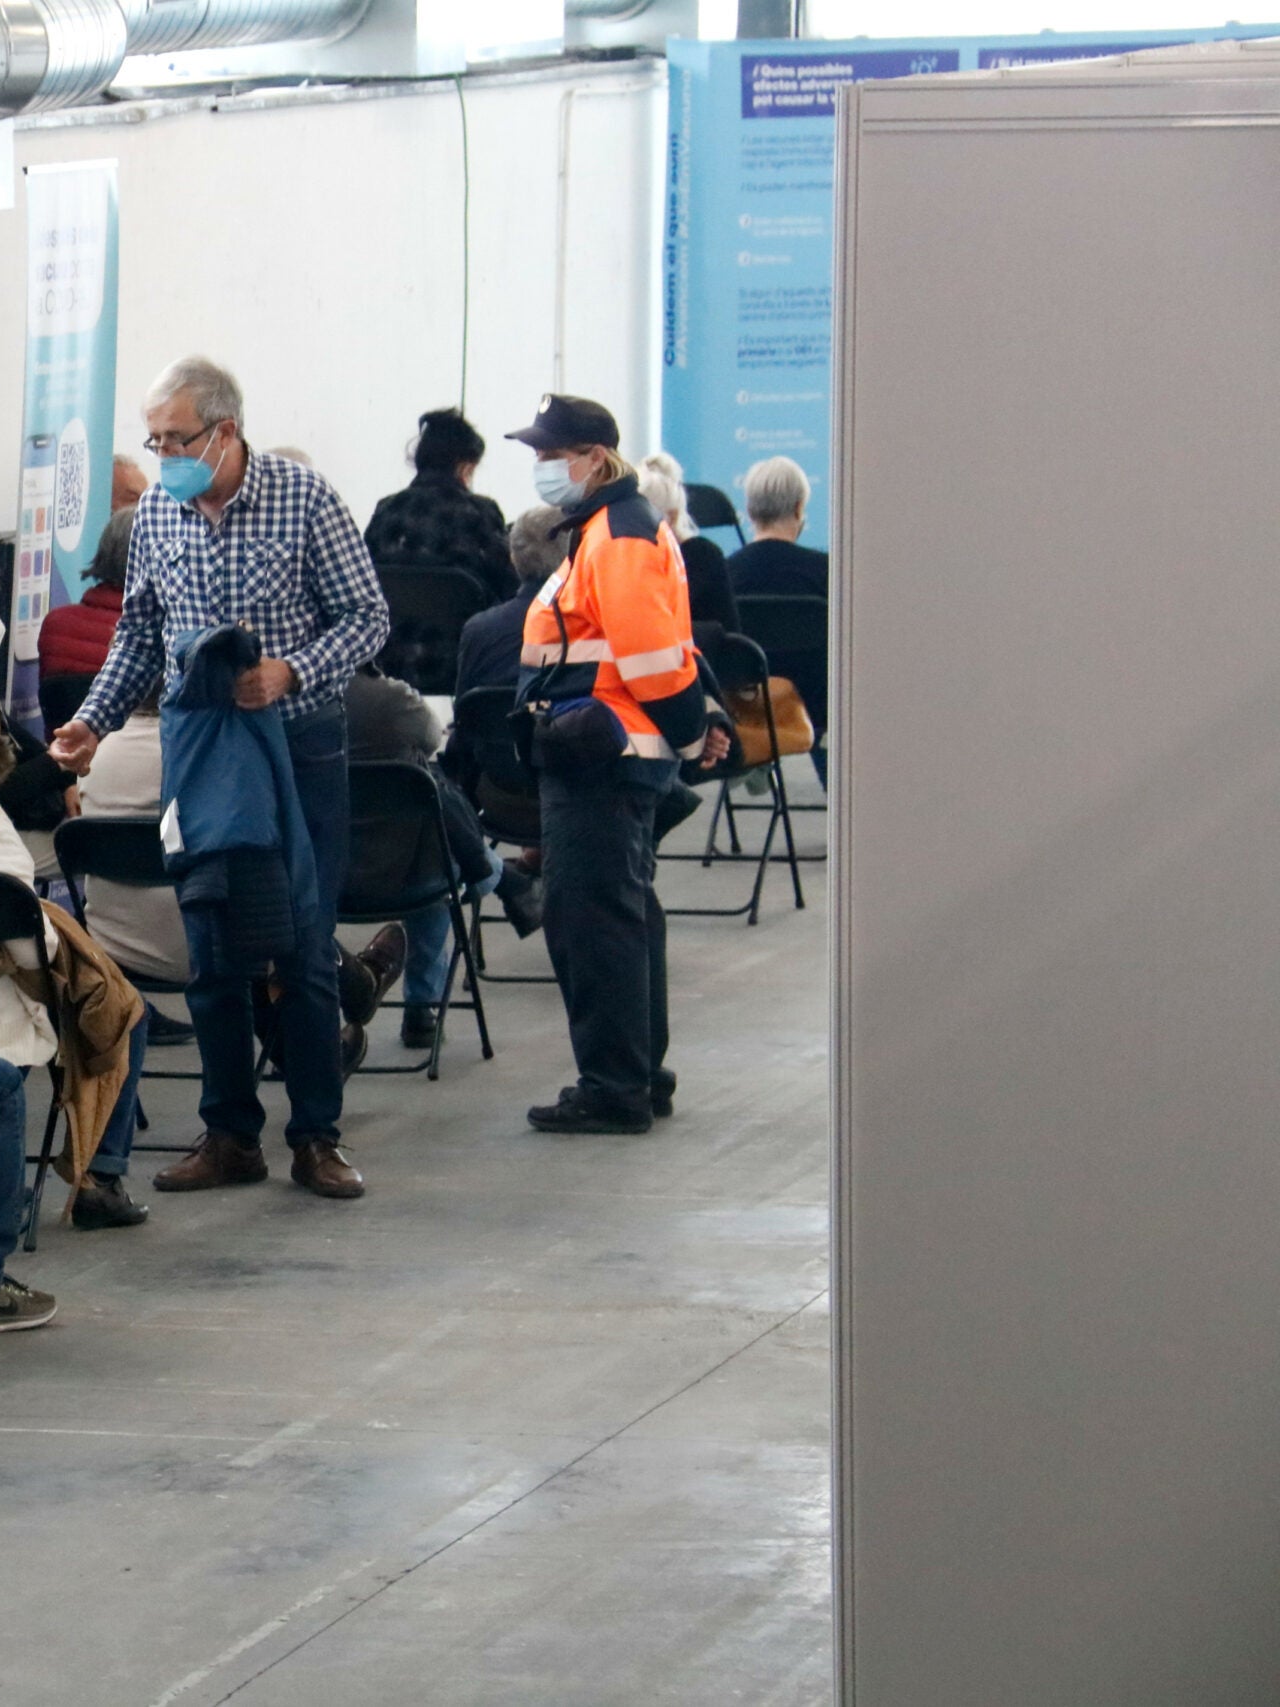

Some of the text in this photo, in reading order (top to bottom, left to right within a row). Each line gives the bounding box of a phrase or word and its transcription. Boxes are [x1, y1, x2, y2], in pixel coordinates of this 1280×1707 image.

[760, 63, 796, 77] Quins
[797, 62, 854, 79] possibles
[753, 79, 799, 92] efectes
[752, 94, 773, 108] pot
[775, 94, 815, 106] causar
[667, 192, 679, 237] que
[665, 245, 677, 266] el
[664, 273, 677, 367] Cuidem
